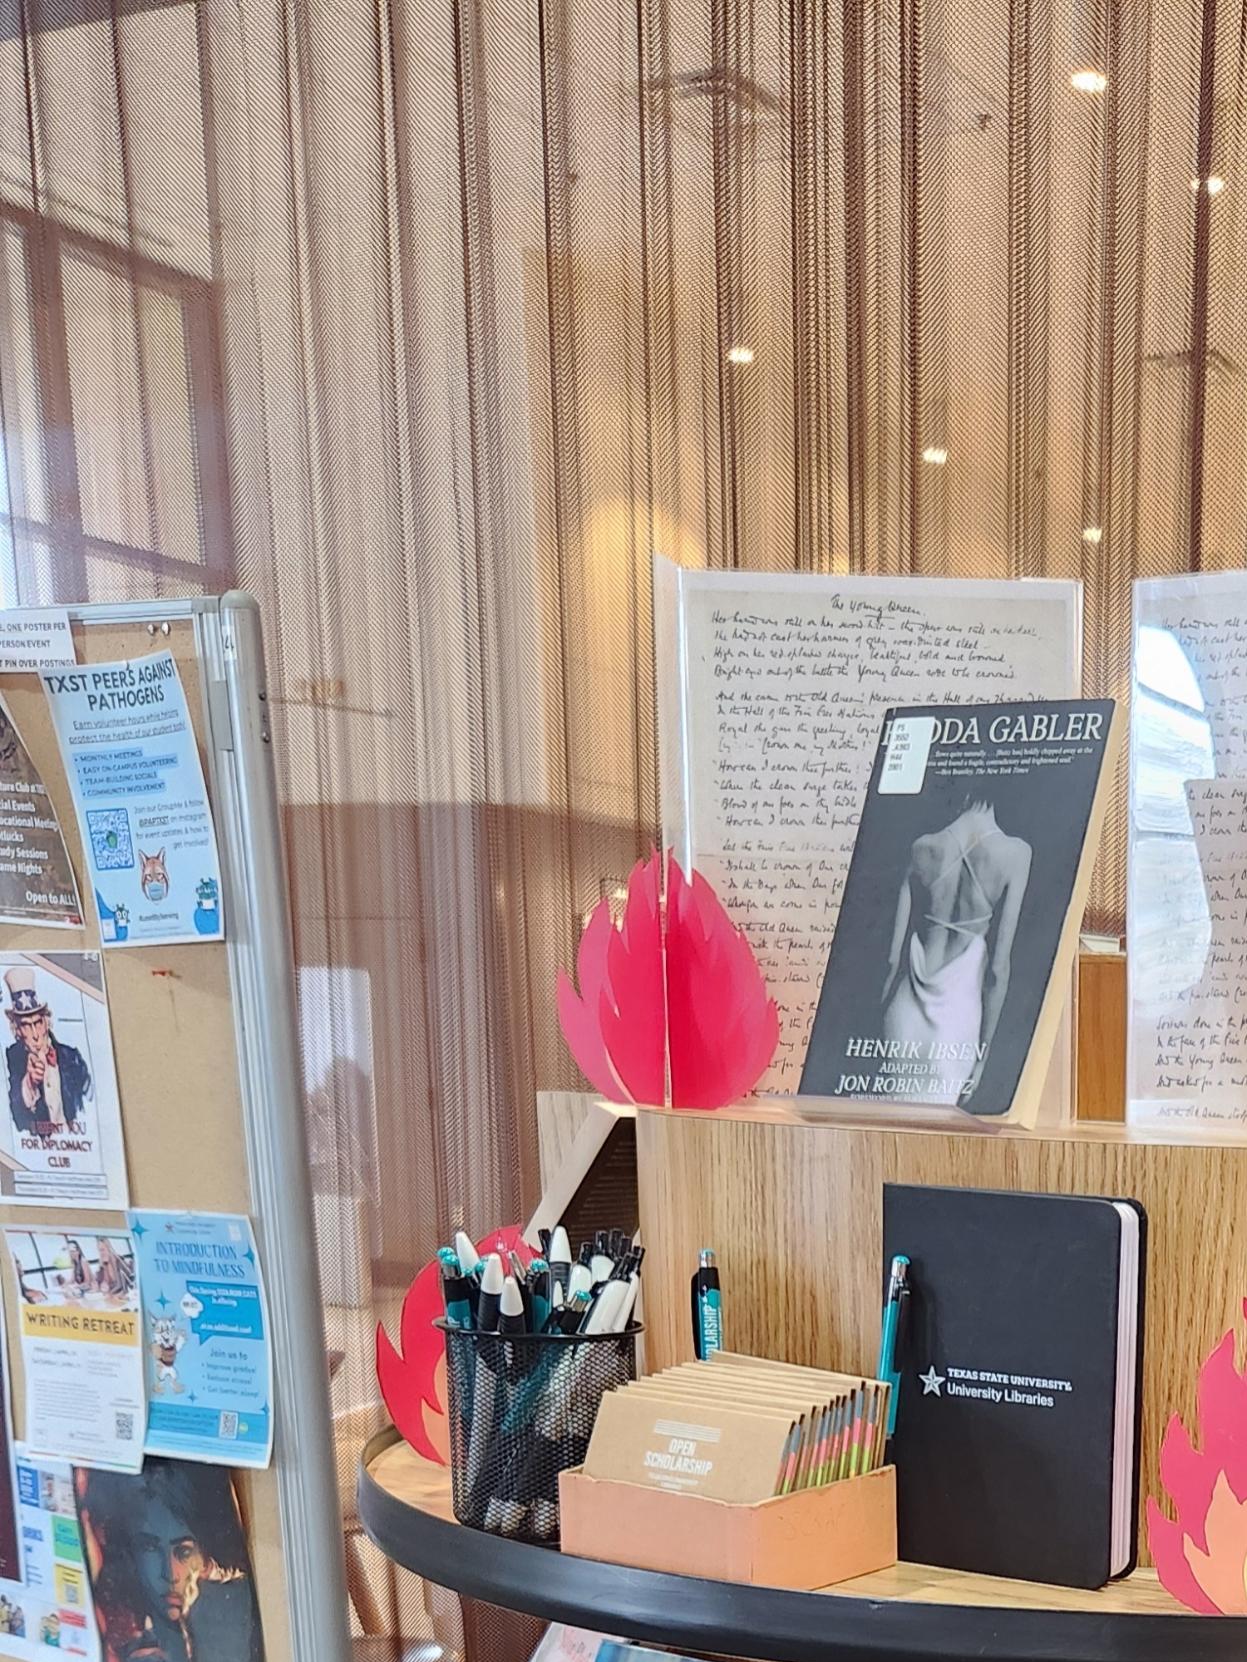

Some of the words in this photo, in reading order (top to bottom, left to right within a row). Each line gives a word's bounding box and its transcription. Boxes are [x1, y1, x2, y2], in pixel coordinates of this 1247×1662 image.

[7, 623, 22, 631] ONE
[23, 622, 51, 631] POSTER
[54, 622, 66, 630] PER
[27, 640, 51, 648] EVENT
[5, 660, 17, 668] PIN
[44, 674, 87, 694] TXST
[92, 669, 136, 690] PEERS
[138, 658, 176, 686] AGAINST
[87, 685, 164, 711] PATHOGENS
[989, 713, 1103, 743] GABLER
[83, 766, 100, 774] EASY
[12, 800, 35, 812] Events
[16, 847, 48, 860] Sessions
[18, 863, 42, 876] Nights
[26, 891, 48, 905] Open
[48, 893, 58, 904] to
[846, 1038, 922, 1059] HENRIK
[928, 1041, 988, 1061] IBSEN
[879, 1061, 927, 1074] ADAPTED
[834, 1074, 870, 1094] JON
[872, 1076, 924, 1094] ROBIN
[21, 1138, 40, 1149] FOR
[42, 1140, 93, 1152] DIPLOMACY
[48, 1156, 71, 1167] CLUB
[156, 1241, 237, 1259] INTRODUCTION
[154, 1258, 169, 1273] TO
[171, 1261, 245, 1279] MINDFULNESS
[26, 1312, 79, 1329] WRITING
[83, 1317, 134, 1335] RETREAT
[947, 1368, 978, 1380] TEXAS
[980, 1372, 1009, 1384] STATE
[1010, 1375, 1072, 1392] UNIVERSITY
[947, 1382, 1002, 1403] University
[1004, 1389, 1054, 1407] Libraries
[668, 1438, 697, 1455] OPEN
[643, 1450, 713, 1475] SCHOLARSHIP
